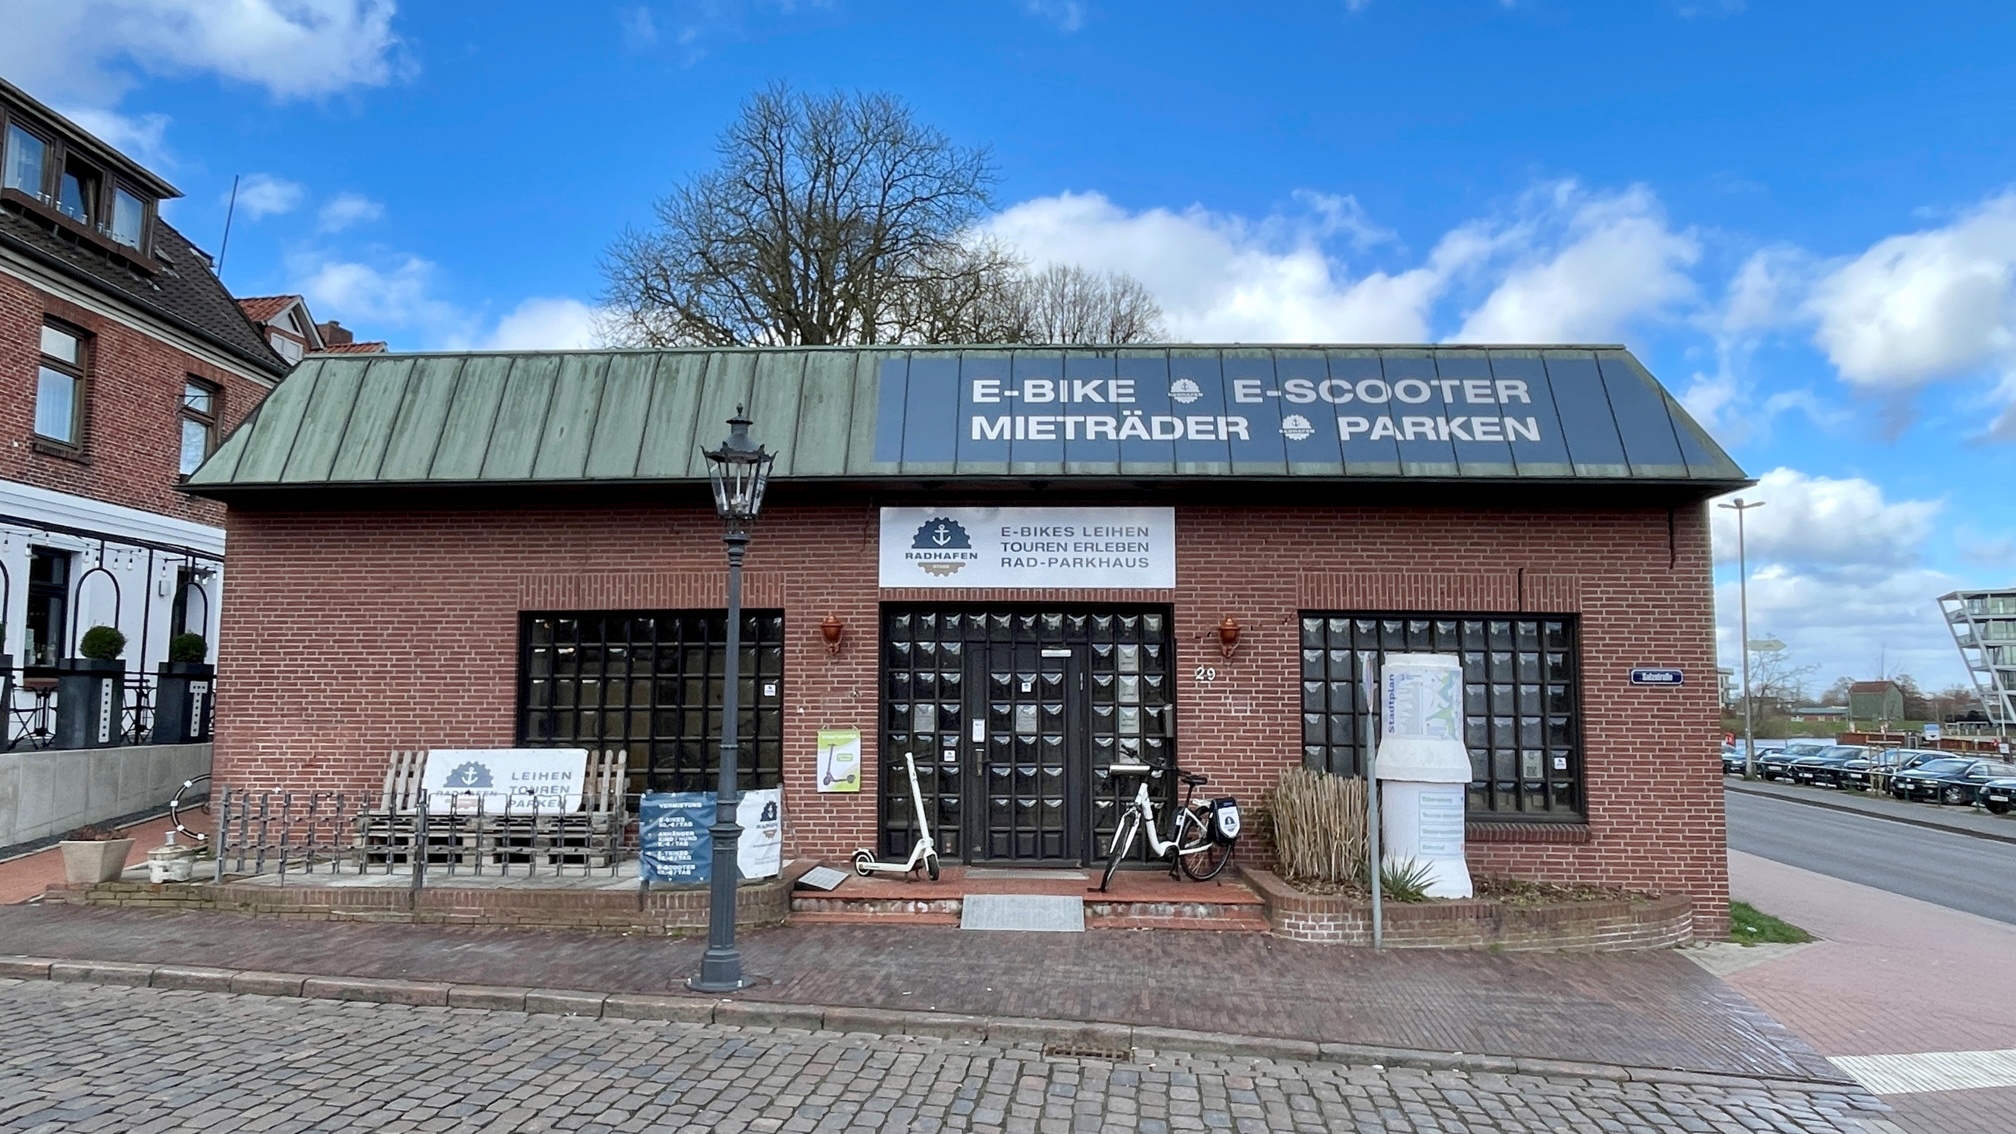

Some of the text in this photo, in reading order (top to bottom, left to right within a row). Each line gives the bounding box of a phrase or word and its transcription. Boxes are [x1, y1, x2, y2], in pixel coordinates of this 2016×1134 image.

[972, 379, 1532, 404] E-BIKE E-SCOOTER
[971, 410, 1541, 441] MIETRÄDER PARKEN
[1001, 526, 1149, 537] E-BIKES LEIHEN
[1001, 542, 1149, 553] TOUREN ERLEBEN
[905, 552, 978, 560] RADHAFEN
[1001, 557, 1149, 568] RAD-PARKHAUS
[1195, 667, 1216, 681] 29
[1388, 674, 1396, 734] Stadtplan
[511, 771, 572, 781] LEIHEN
[509, 785, 570, 795] TOUREN
